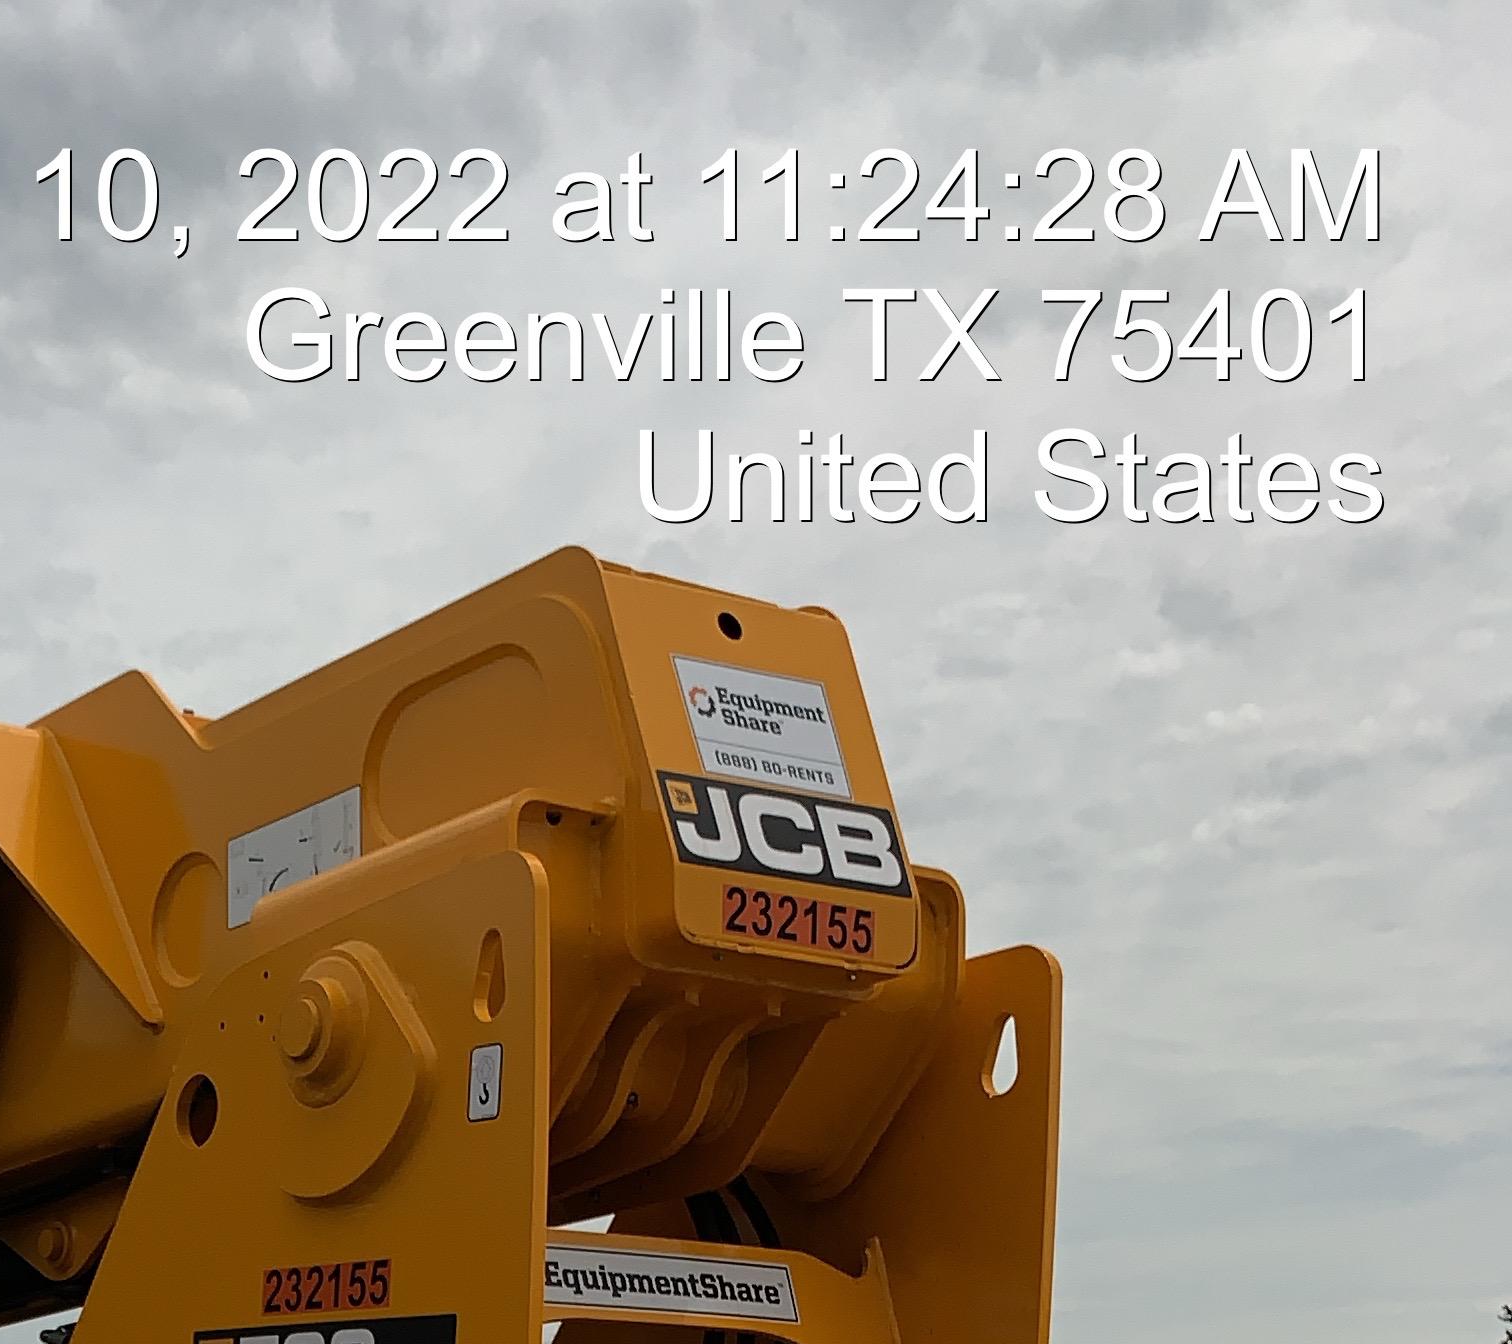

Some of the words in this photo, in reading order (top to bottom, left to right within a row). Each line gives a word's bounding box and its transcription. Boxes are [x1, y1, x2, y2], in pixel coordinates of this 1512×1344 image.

[715, 686, 827, 724] Equipment
[721, 708, 782, 736] Share
[714, 750, 758, 772] (888)
[676, 785, 903, 888] JCB
[725, 886, 873, 953] 232155
[263, 1260, 389, 1313] 232155
[543, 1260, 782, 1304] EquipmentShare
